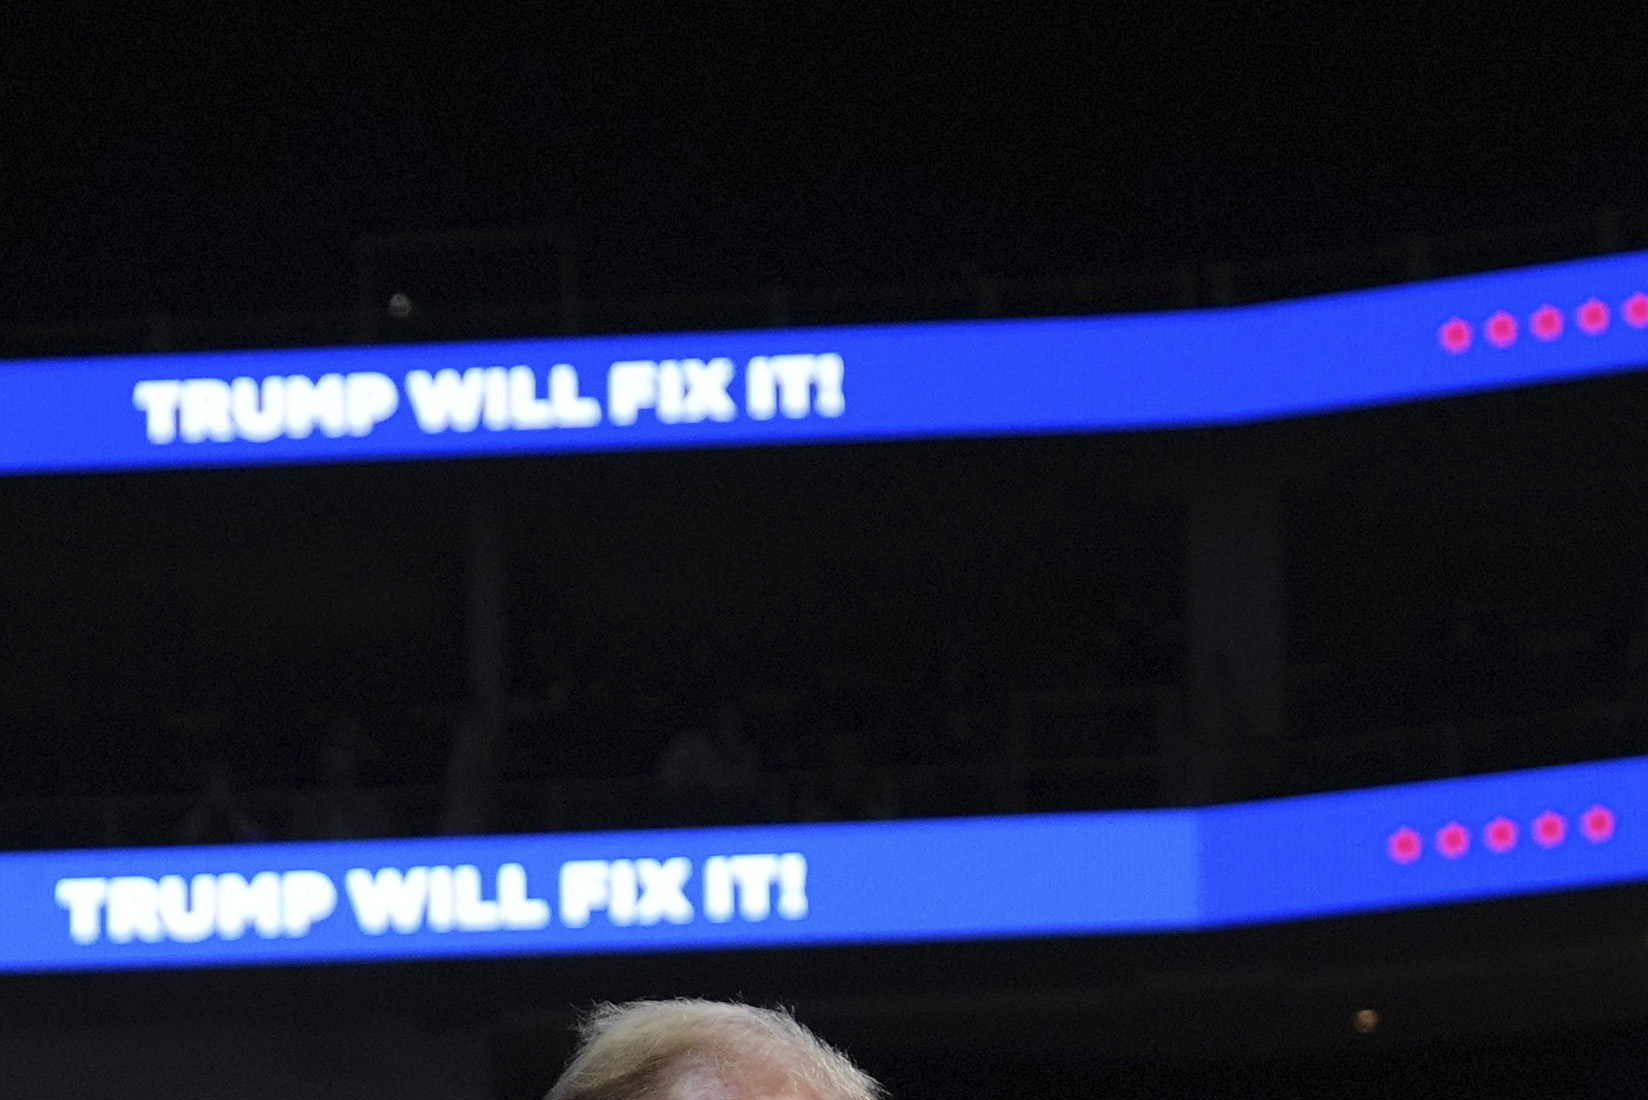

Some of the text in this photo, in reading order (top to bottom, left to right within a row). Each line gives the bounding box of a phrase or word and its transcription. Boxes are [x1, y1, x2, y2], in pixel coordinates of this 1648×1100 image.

[133, 353, 845, 444] TRUMP WILL FIX IT!
[55, 853, 808, 944] TRUMP WILL FIX IT!
